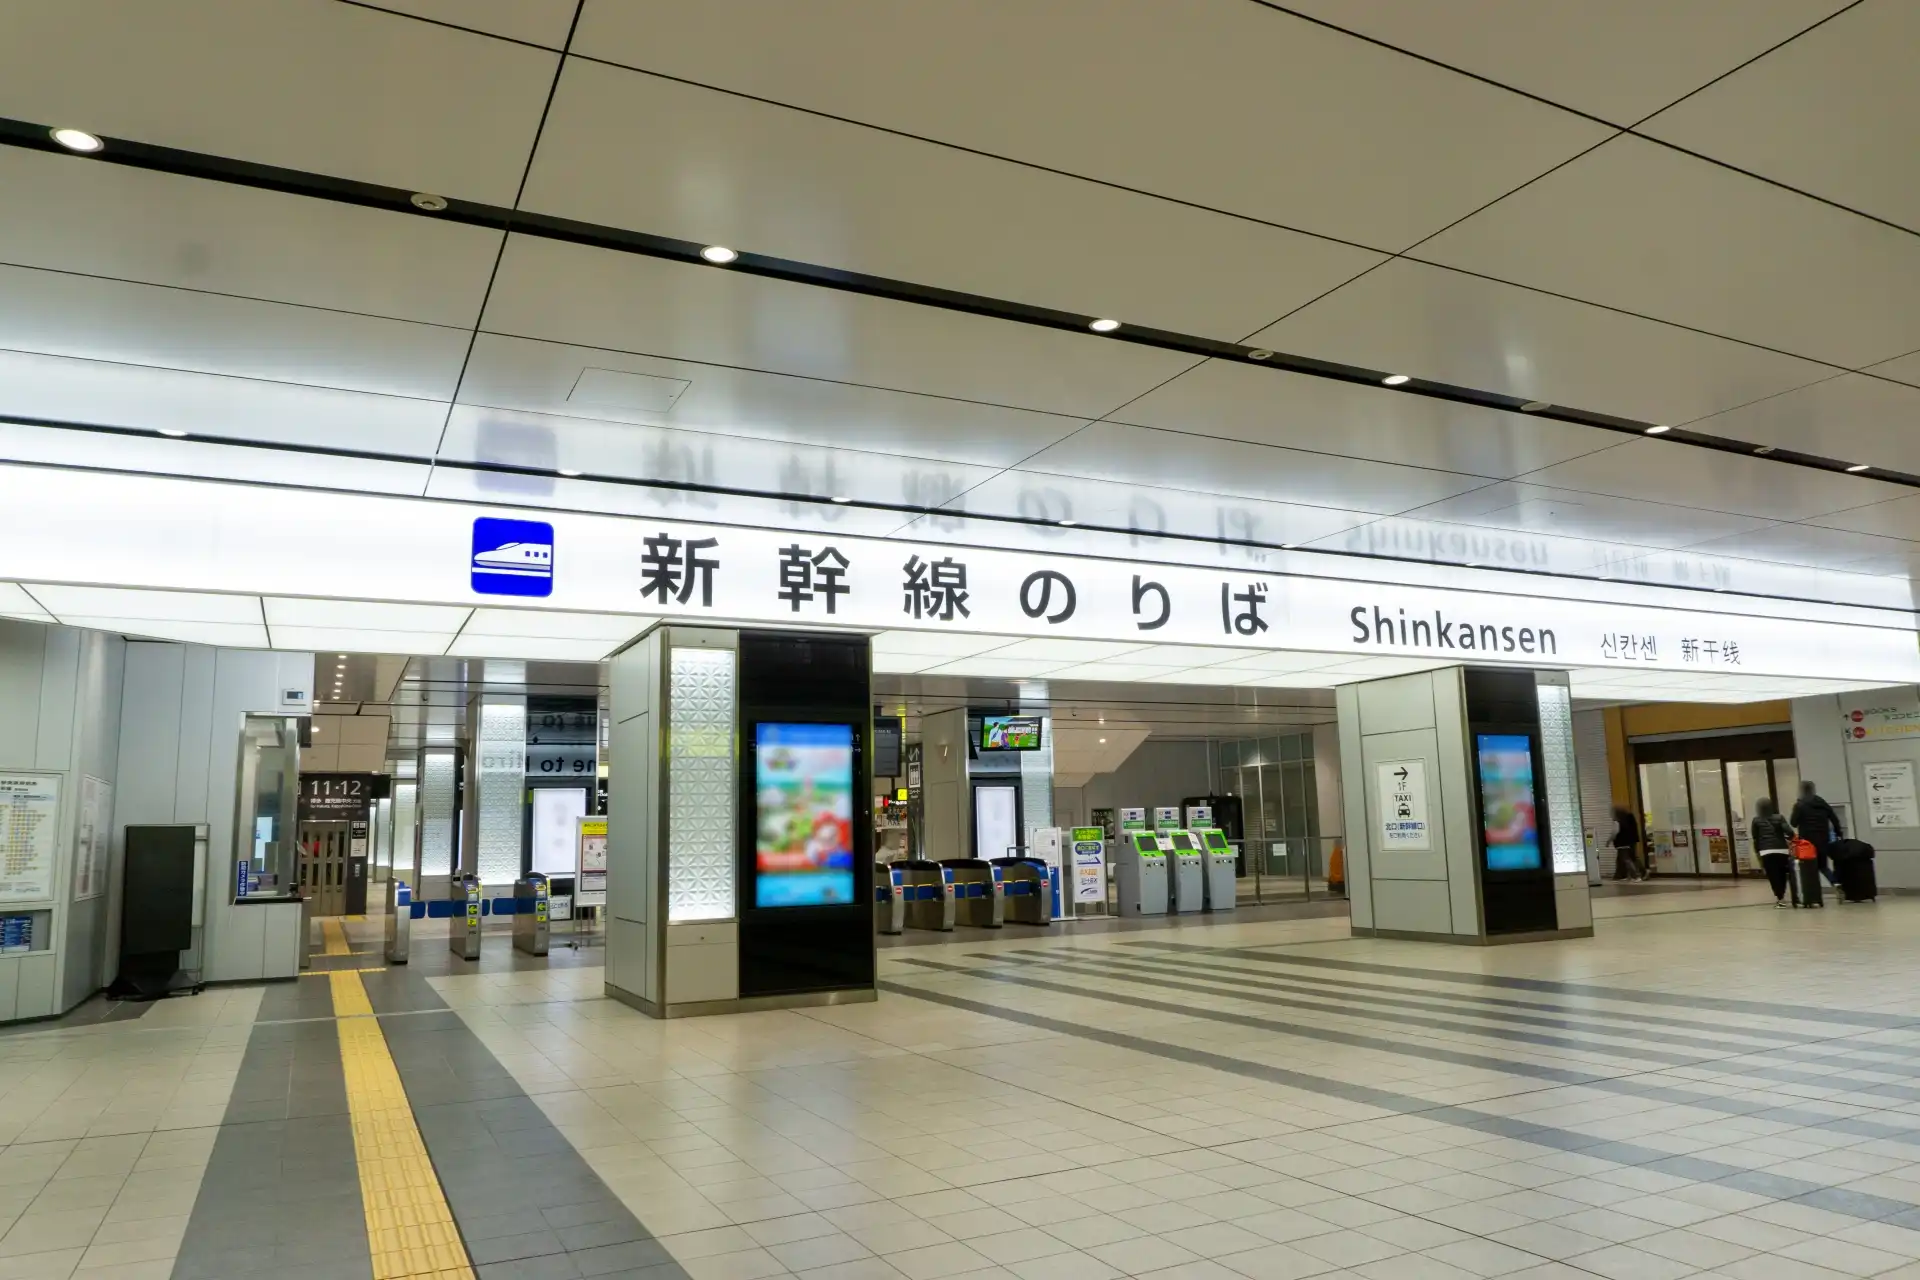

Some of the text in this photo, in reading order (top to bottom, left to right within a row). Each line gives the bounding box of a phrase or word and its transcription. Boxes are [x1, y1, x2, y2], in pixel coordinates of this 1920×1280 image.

[640, 533, 1269, 636] 新幹線のりば
[1351, 606, 1556, 655] Shinkansen
[1600, 632, 1657, 662] 신칸센
[1681, 637, 1741, 665] 新干线
[1394, 794, 1412, 802] TAXI
[1398, 782, 1407, 791] 1F
